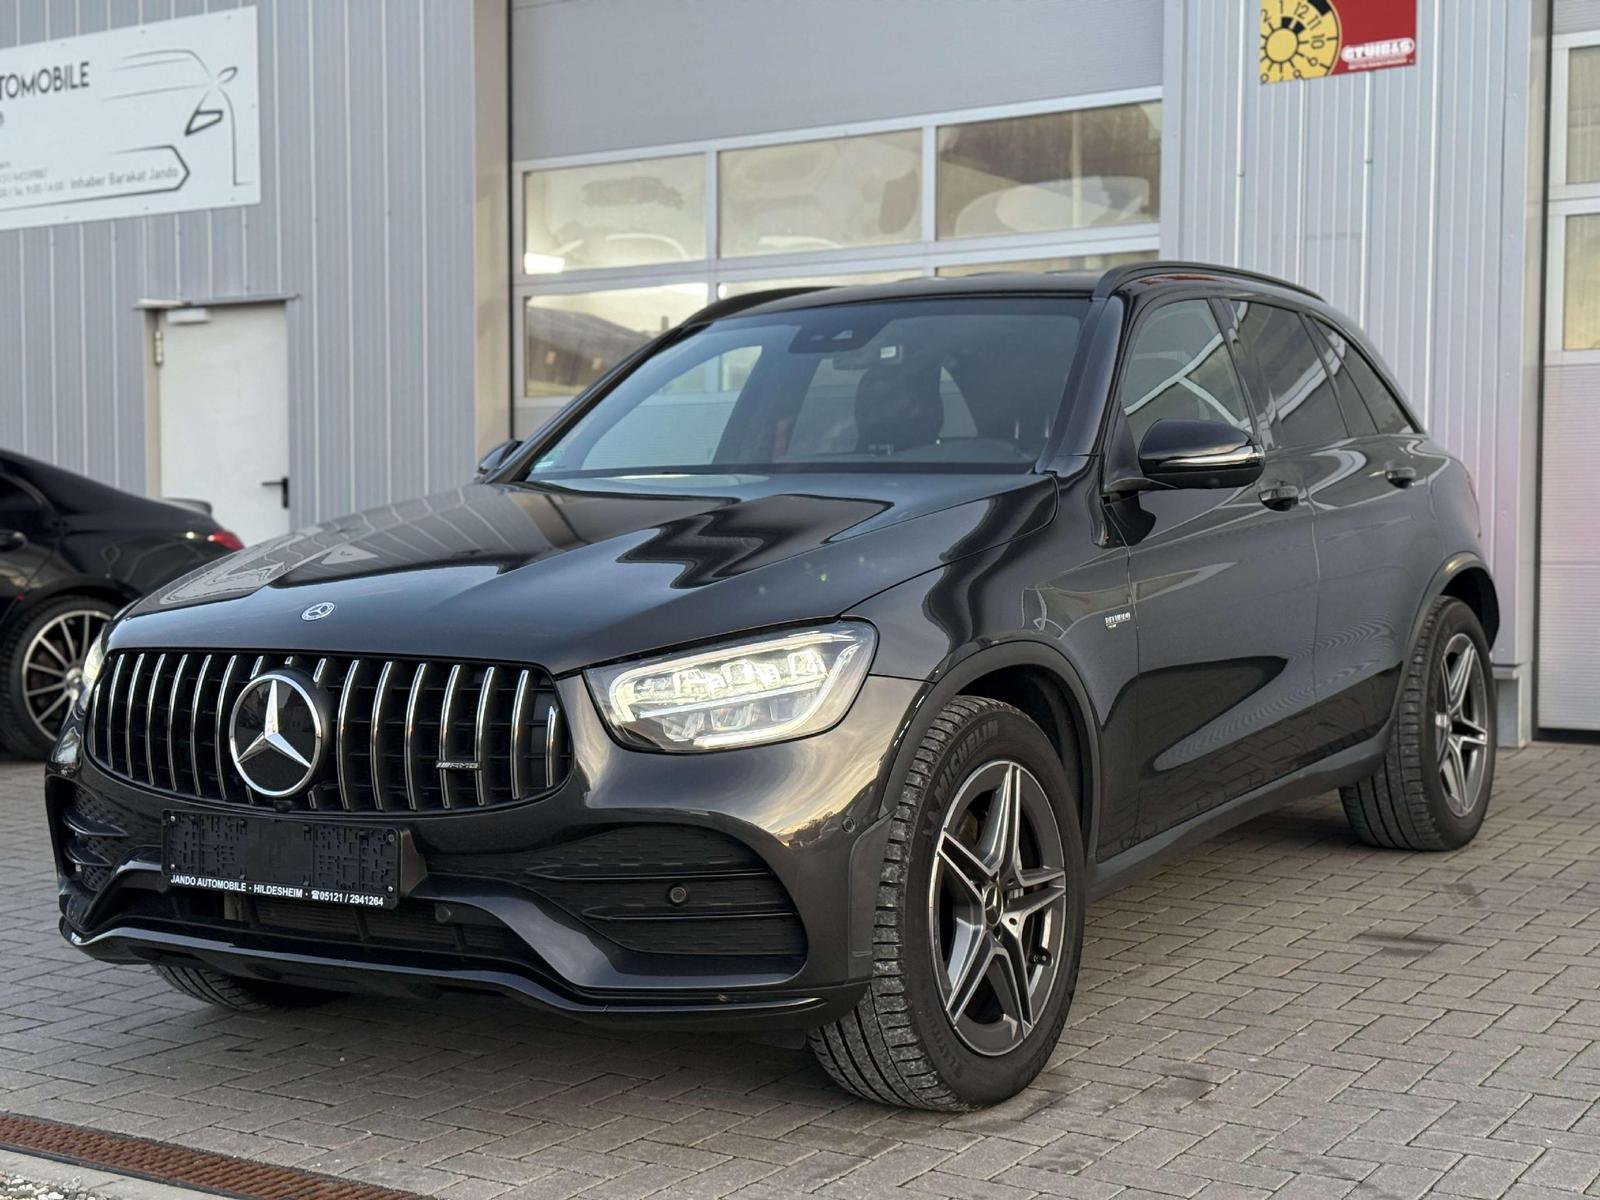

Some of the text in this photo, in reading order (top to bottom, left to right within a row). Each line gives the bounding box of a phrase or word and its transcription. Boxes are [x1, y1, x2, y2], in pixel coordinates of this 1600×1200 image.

[1294, 2, 1310, 20] 12
[1307, 14, 1322, 31] 11
[1311, 34, 1326, 50] 10
[935, 720, 1000, 802] MICHELIN
[170, 874, 196, 886] JANDO
[196, 877, 247, 892] AUTOMOBILE
[253, 884, 303, 898] HILDESHEIM
[319, 891, 343, 902] 05121
[349, 894, 384, 907] 2941264
